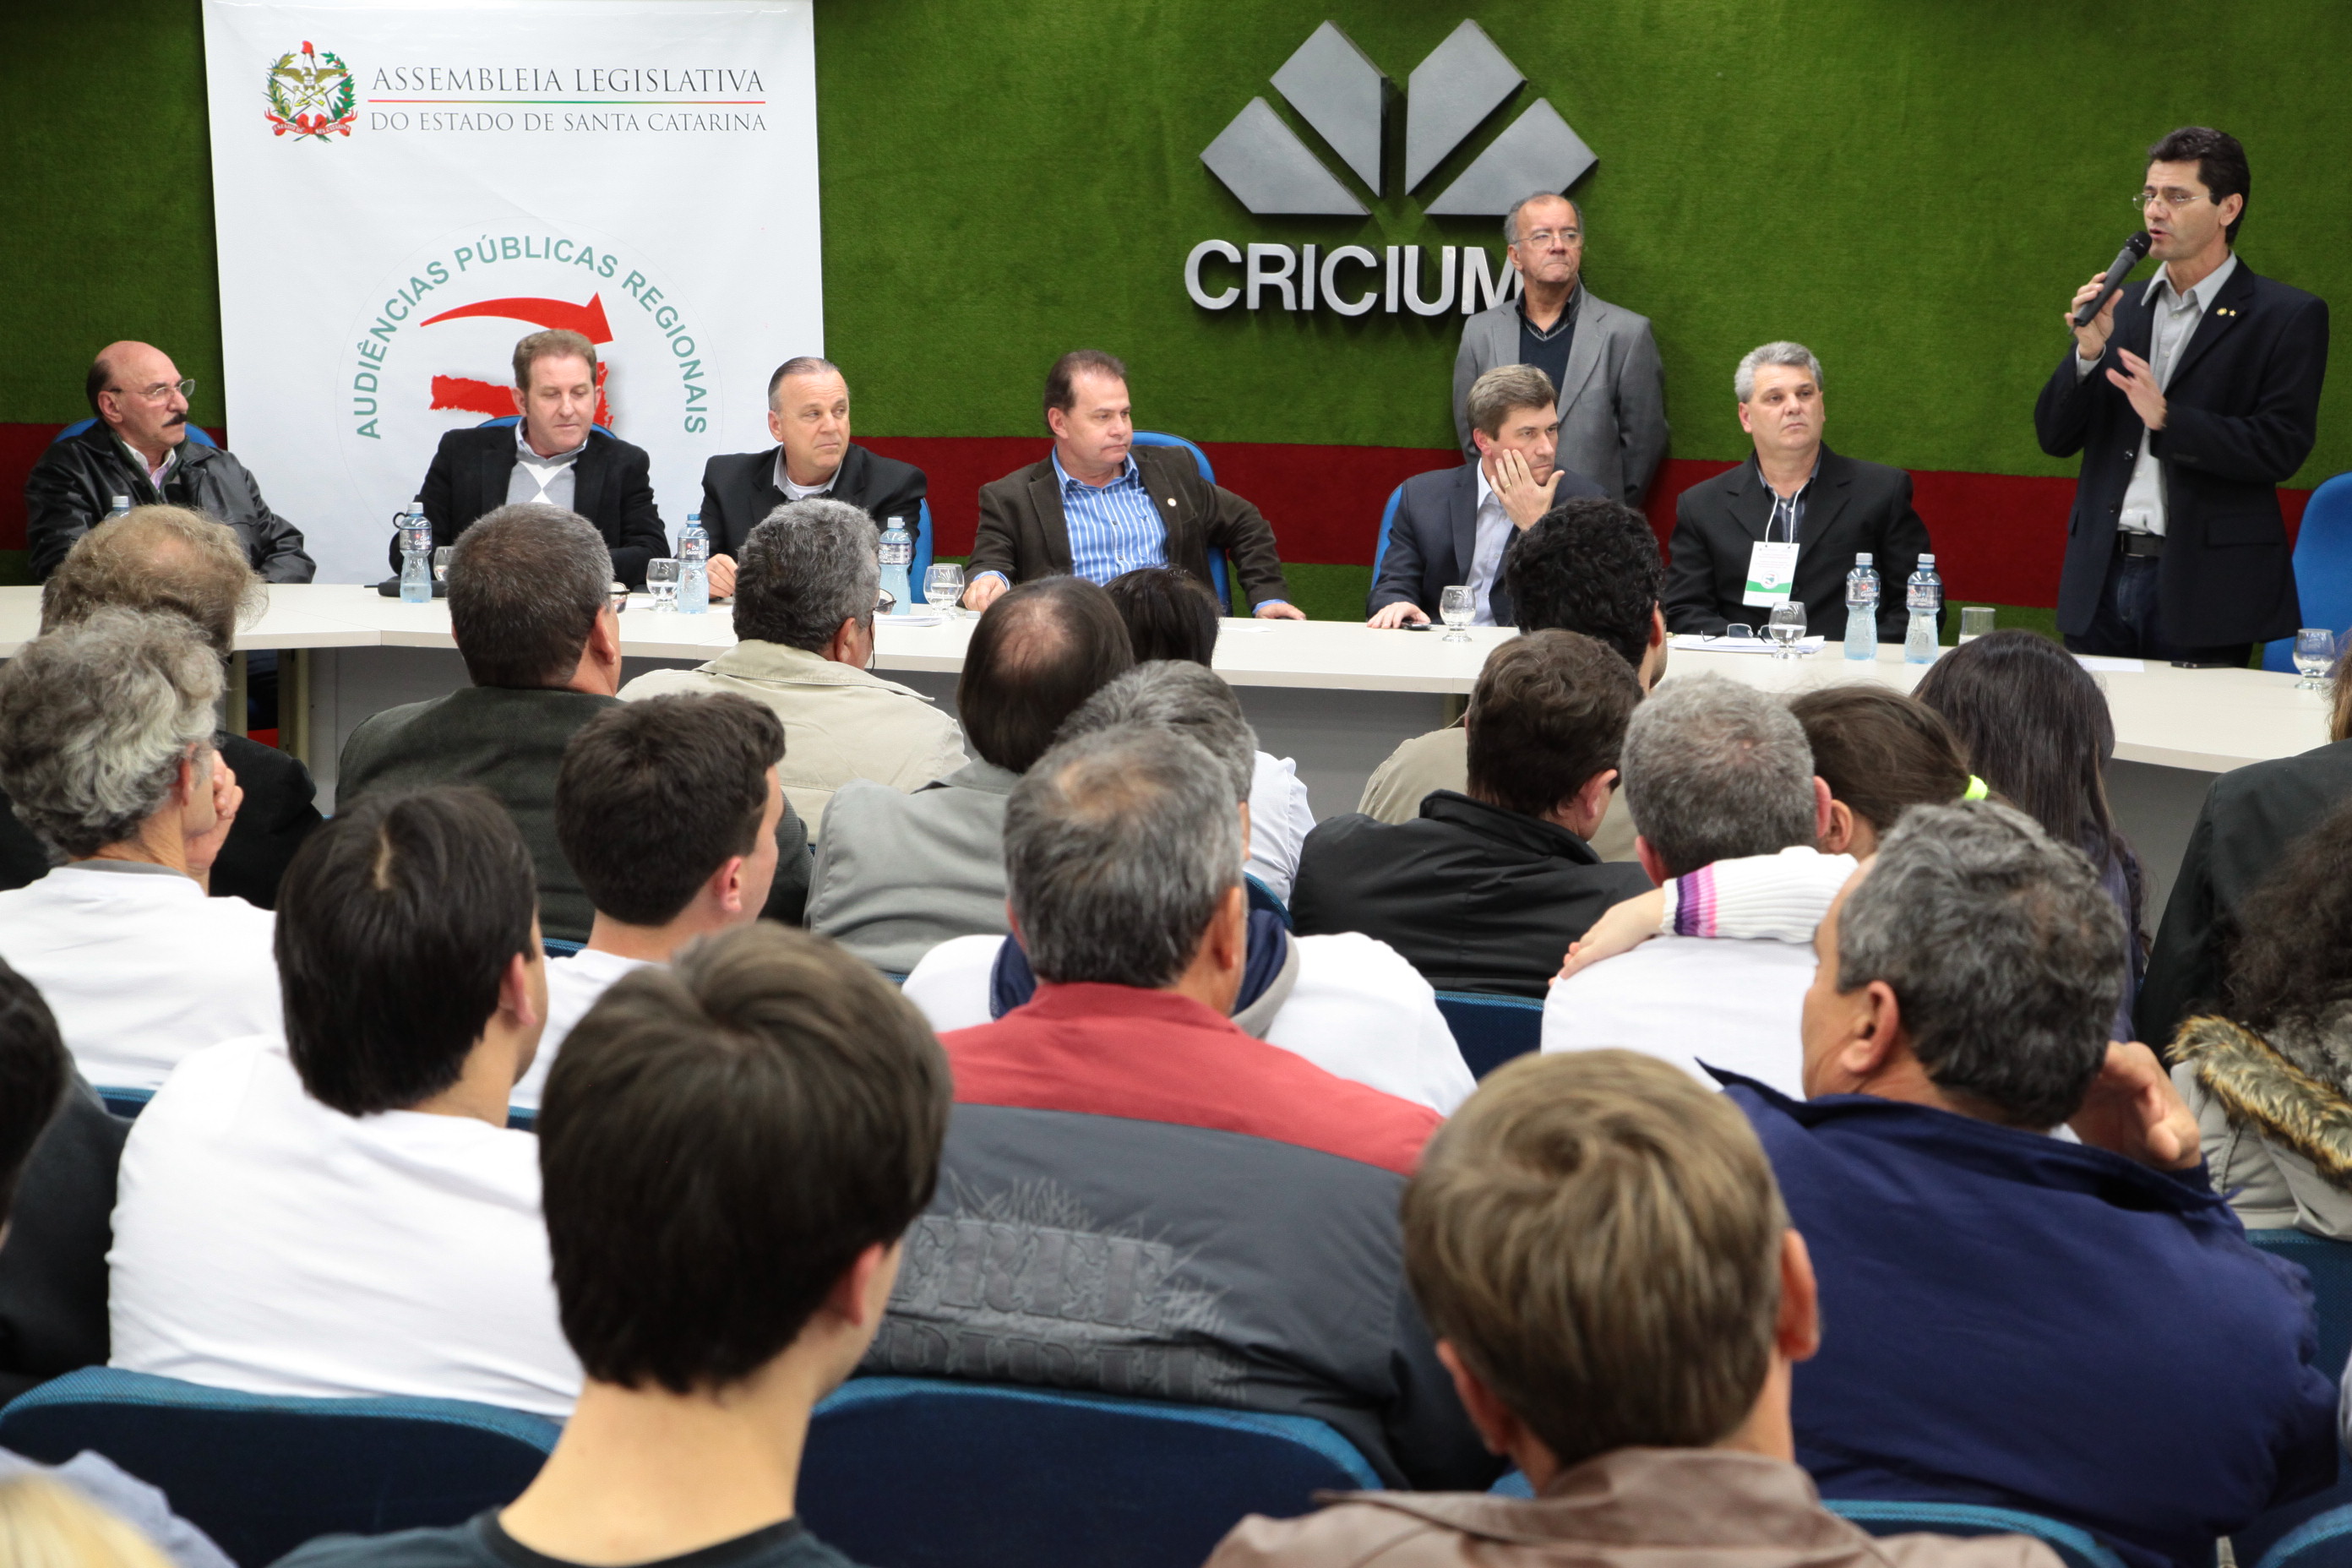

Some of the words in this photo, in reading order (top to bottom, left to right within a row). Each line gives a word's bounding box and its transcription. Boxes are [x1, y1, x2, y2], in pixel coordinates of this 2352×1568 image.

[372, 68, 564, 92] ASSEMBLEIA
[576, 68, 764, 92] LEGISLATIVA
[371, 112, 411, 131] DO
[420, 112, 514, 131] ESTADO
[525, 113, 554, 131] DE
[565, 113, 640, 131] SANTA
[649, 113, 767, 132] CATARINA
[353, 260, 449, 439] AUDIÊNCIAS
[455, 234, 618, 279] PÚBLICAS
[622, 270, 707, 434] REGIONAIS
